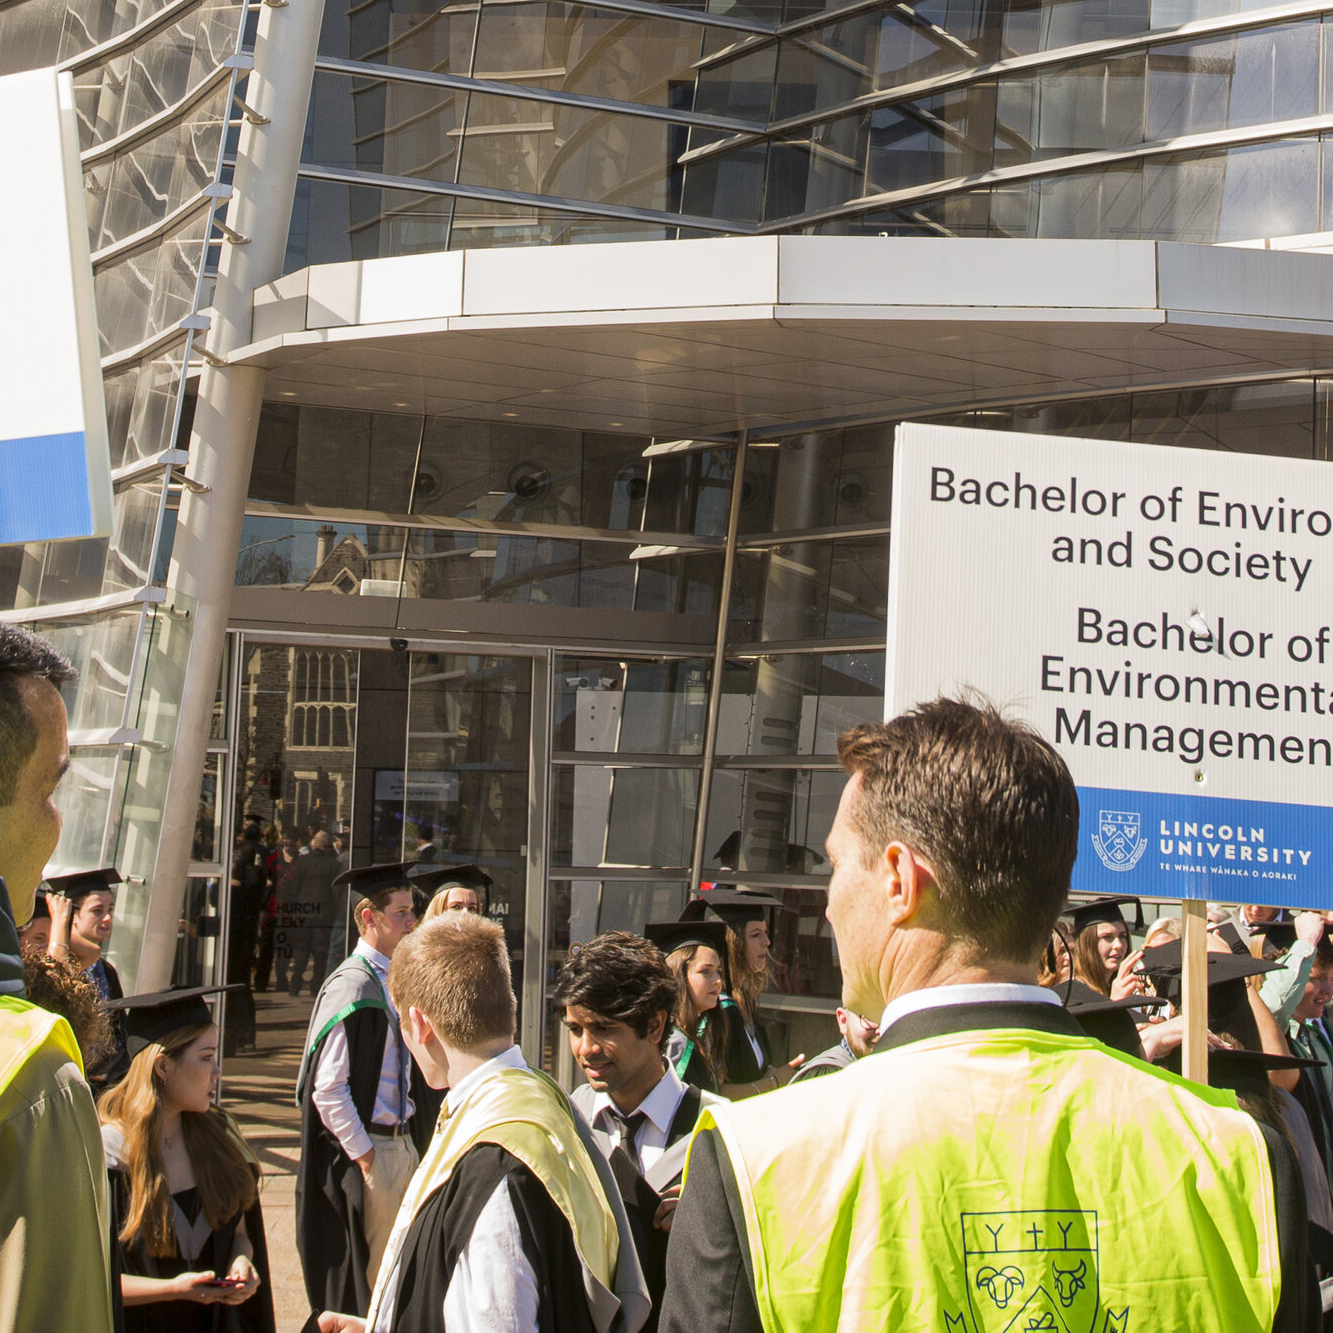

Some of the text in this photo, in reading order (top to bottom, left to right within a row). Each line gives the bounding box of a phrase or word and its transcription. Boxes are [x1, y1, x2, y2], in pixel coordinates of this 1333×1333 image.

[929, 467, 1127, 519] Bachelor
[1139, 487, 1183, 524] of
[1051, 531, 1134, 568] and
[1148, 535, 1313, 592] Society
[1076, 607, 1331, 664] Bachelor of
[1160, 820, 1265, 844] LINCOLN
[1160, 839, 1312, 866] UNIVERSITY
[1174, 864, 1207, 874] WHARE
[1210, 866, 1249, 877] WĀNAKA
[1252, 869, 1259, 878] O
[1262, 871, 1297, 880] AORAKI
